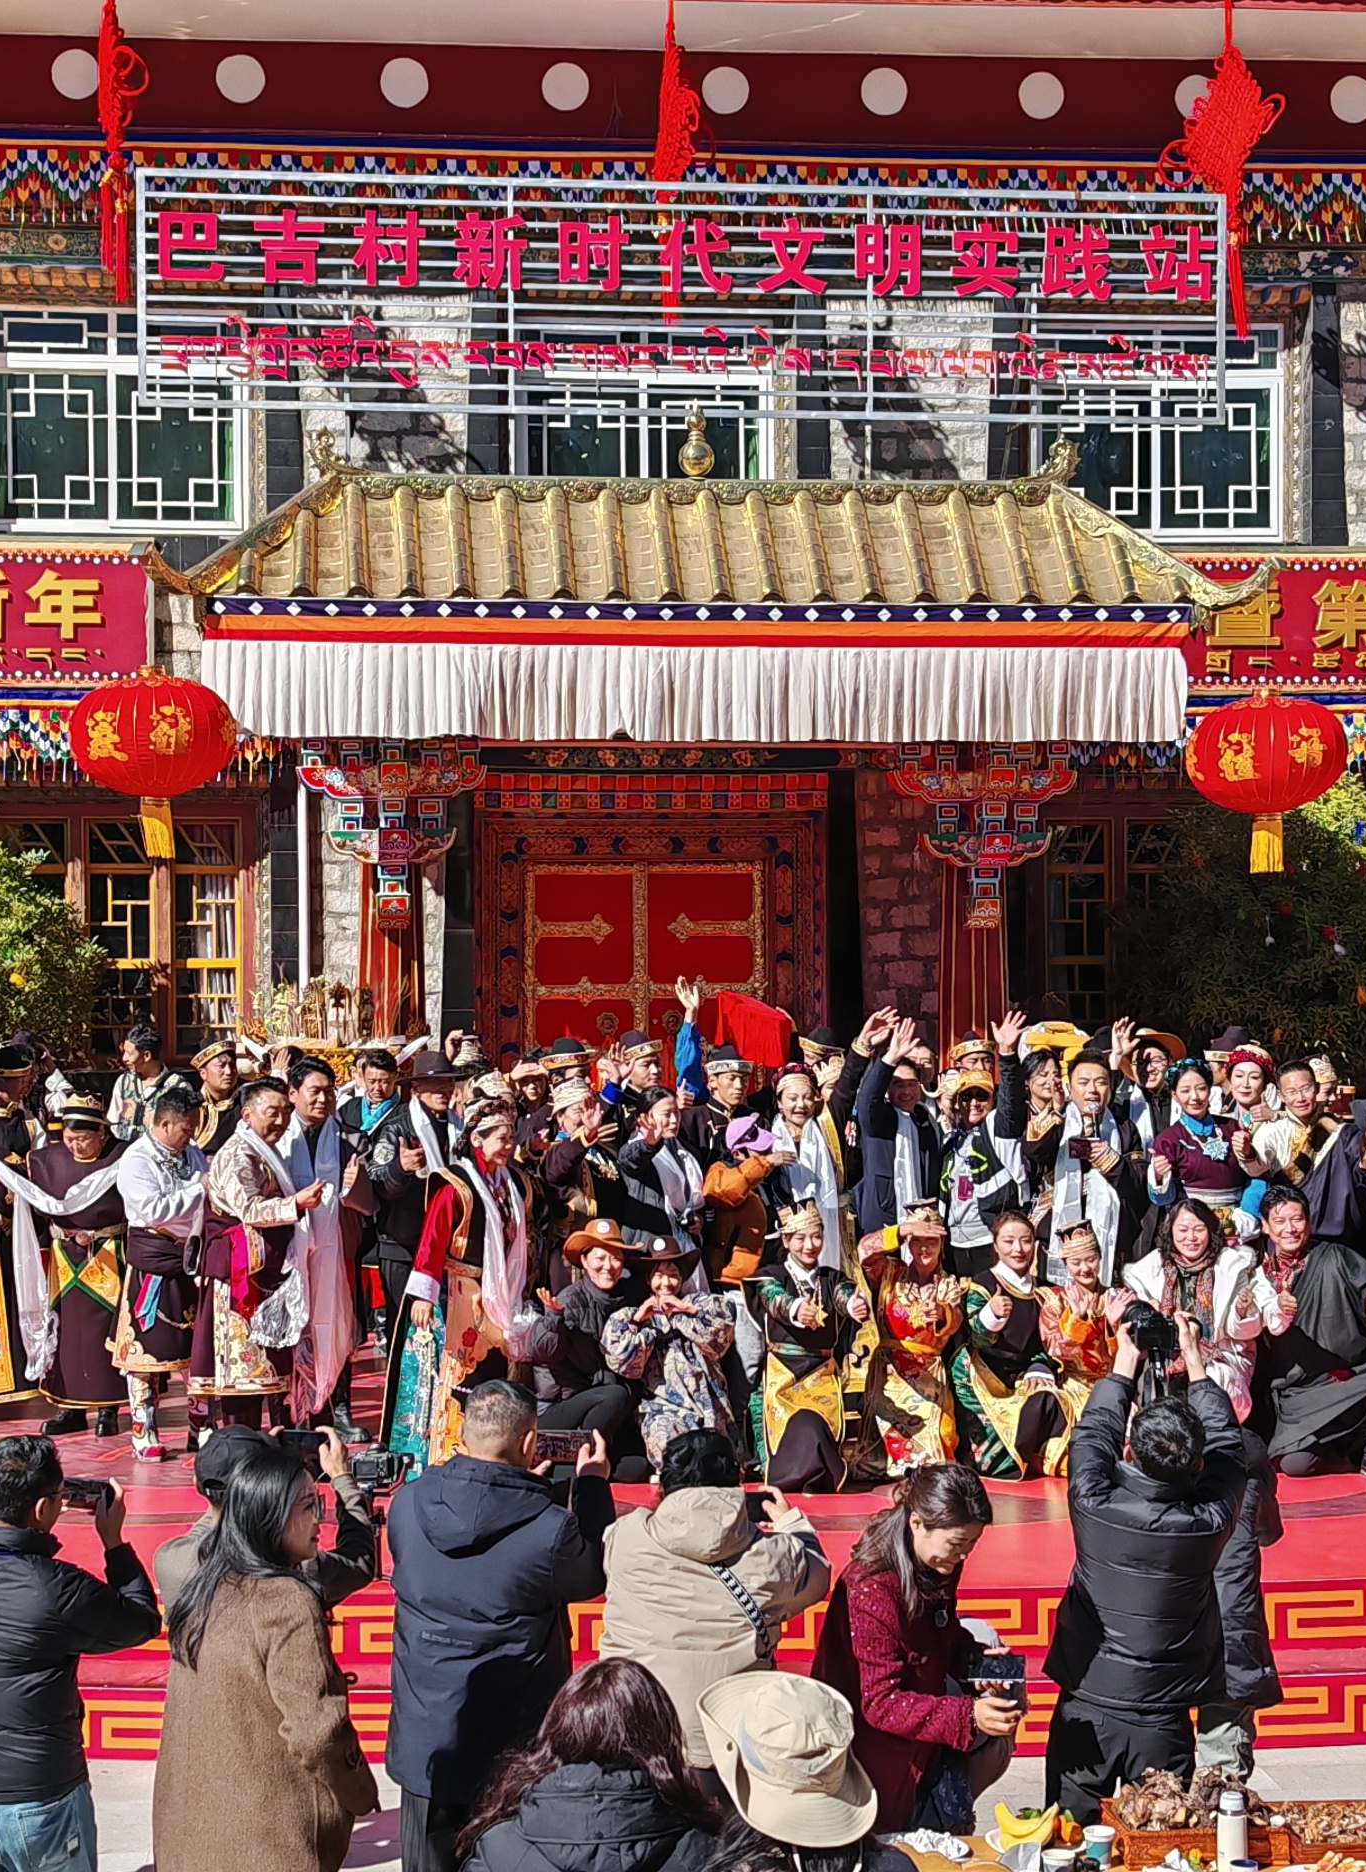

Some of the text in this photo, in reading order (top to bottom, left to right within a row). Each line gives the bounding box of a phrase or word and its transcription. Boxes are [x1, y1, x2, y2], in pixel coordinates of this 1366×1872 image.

[158, 208, 1216, 301] 巴吉村新时代文明实践站
